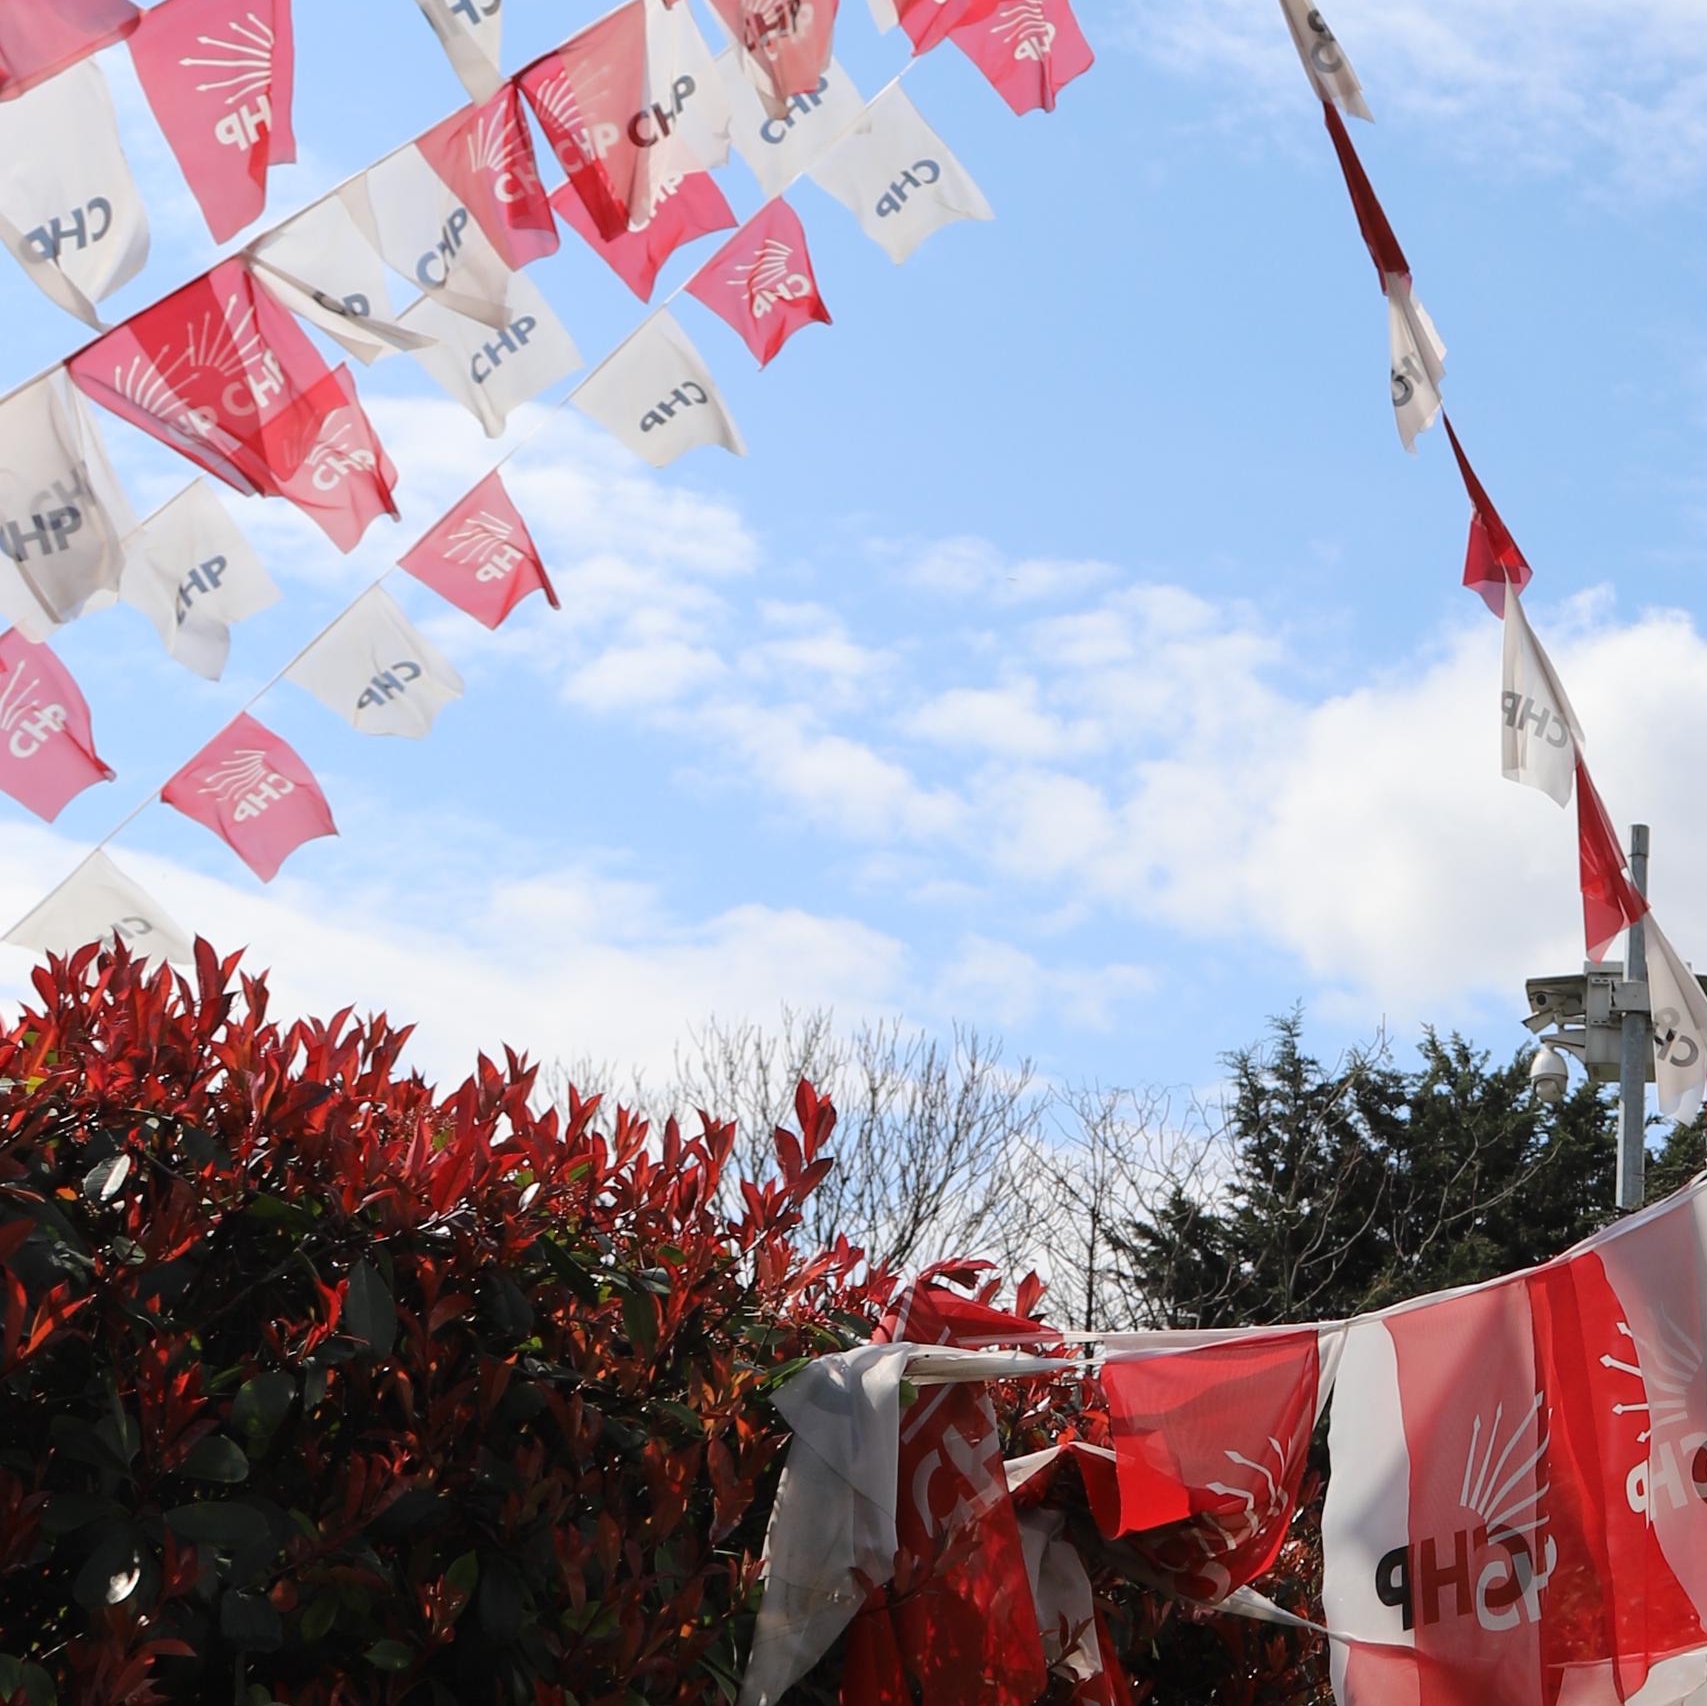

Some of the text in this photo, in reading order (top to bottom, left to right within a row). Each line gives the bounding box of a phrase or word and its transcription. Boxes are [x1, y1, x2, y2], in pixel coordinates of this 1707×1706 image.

[627, 75, 696, 149] CHP
[416, 207, 468, 290] CHP
[470, 315, 538, 385] CHP
[9, 704, 68, 758] CHP
